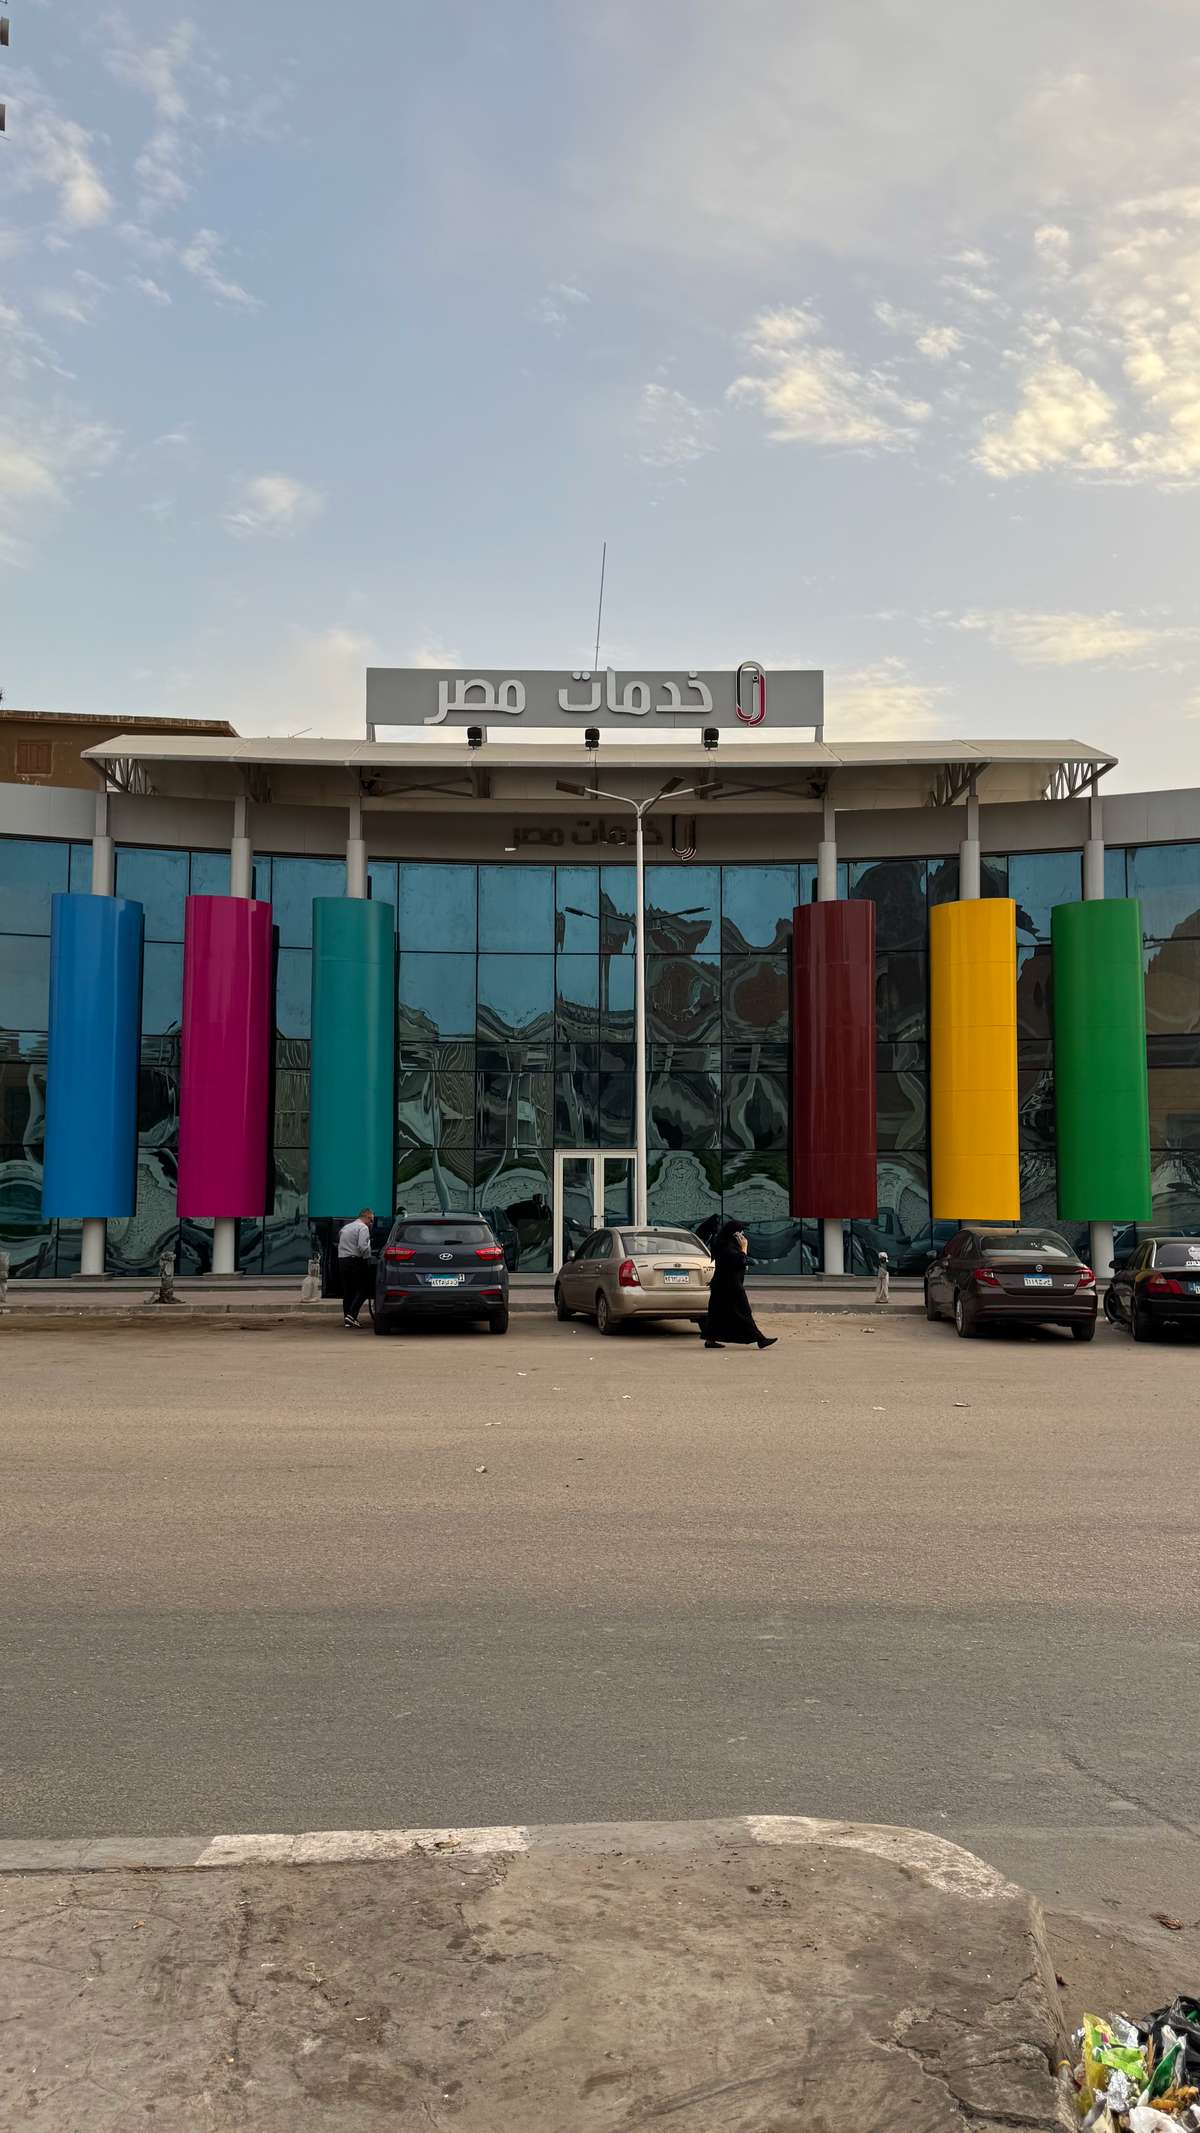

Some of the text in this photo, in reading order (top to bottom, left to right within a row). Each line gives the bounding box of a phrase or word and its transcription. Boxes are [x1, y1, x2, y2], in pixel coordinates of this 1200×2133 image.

[423, 666, 714, 725] خدمات مصر
[504, 825, 564, 852] مصر
